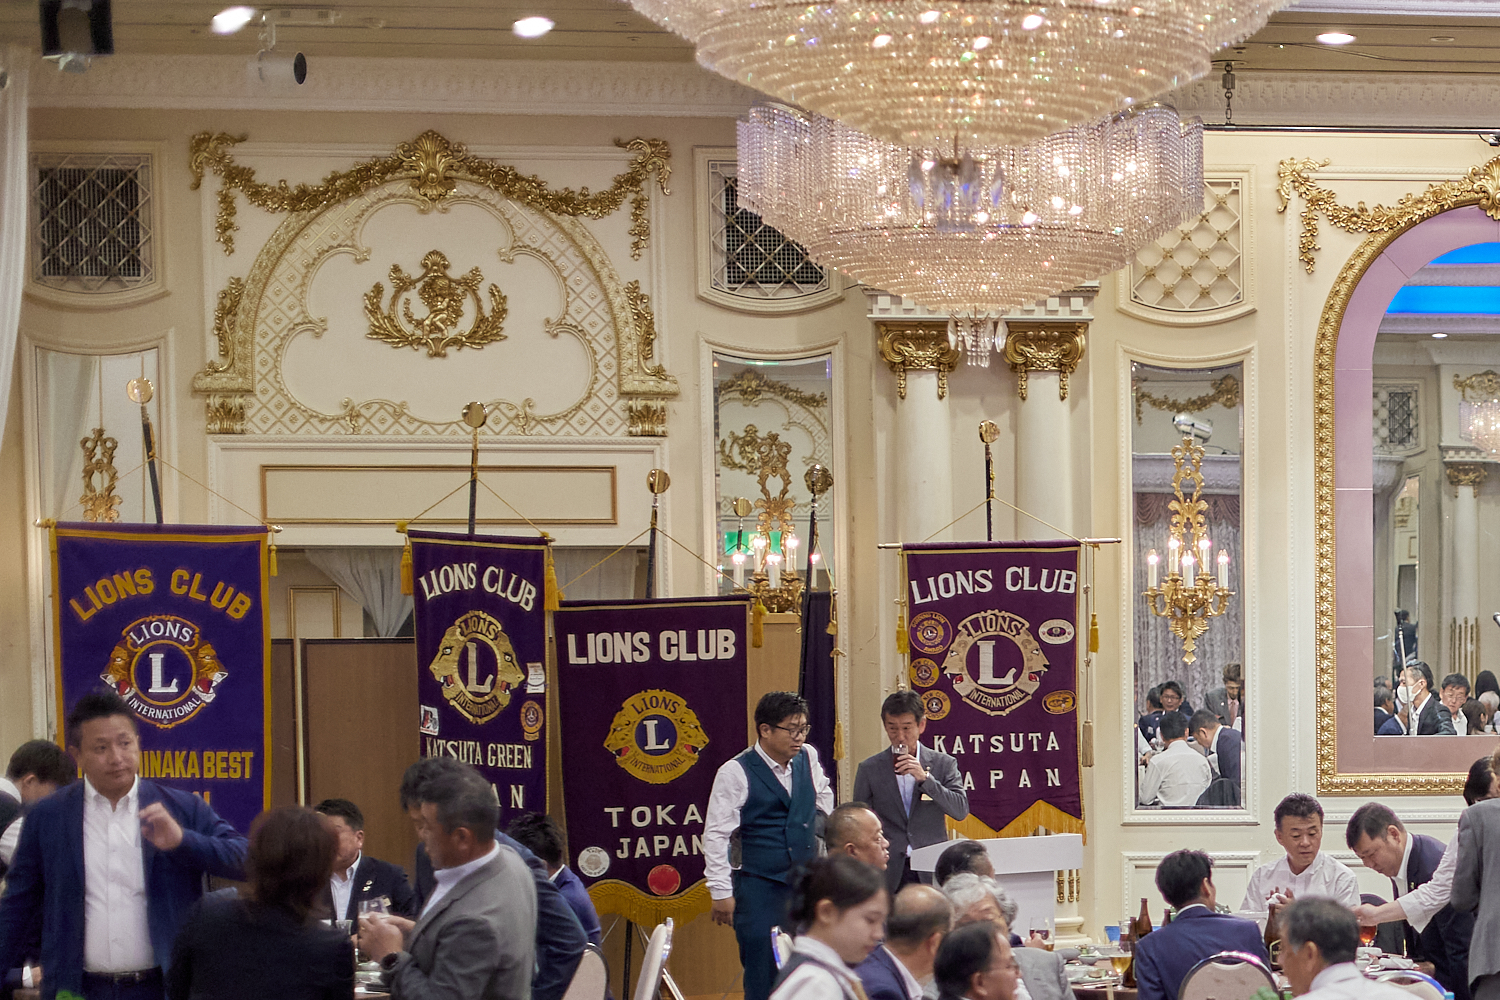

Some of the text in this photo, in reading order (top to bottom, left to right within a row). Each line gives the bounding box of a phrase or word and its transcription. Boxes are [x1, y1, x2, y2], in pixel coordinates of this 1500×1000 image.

[69, 568, 252, 621] LIONS CLUB
[418, 562, 537, 612] LIONS CLUB
[910, 566, 1077, 604] LIONS CLUB
[129, 621, 193, 646] LIONS
[461, 615, 499, 639] LIONS
[966, 614, 1023, 638] LIONS
[567, 629, 736, 665] LIONS CLUB
[148, 653, 178, 692] L
[466, 641, 494, 693] L
[976, 640, 1017, 685] L
[128, 697, 202, 720] INTERNATIONAL
[631, 695, 681, 715] LIONS
[969, 688, 1026, 708] INTERNATIONAL
[925, 708, 947, 720] PONSOR
[643, 719, 670, 750] L
[933, 731, 1060, 755] KATSUTA
[203, 751, 254, 779] BEST
[426, 737, 532, 769] KATSUTA GREEN
[629, 757, 687, 774] INTERNATIONAL
[963, 768, 1062, 791] APAN
